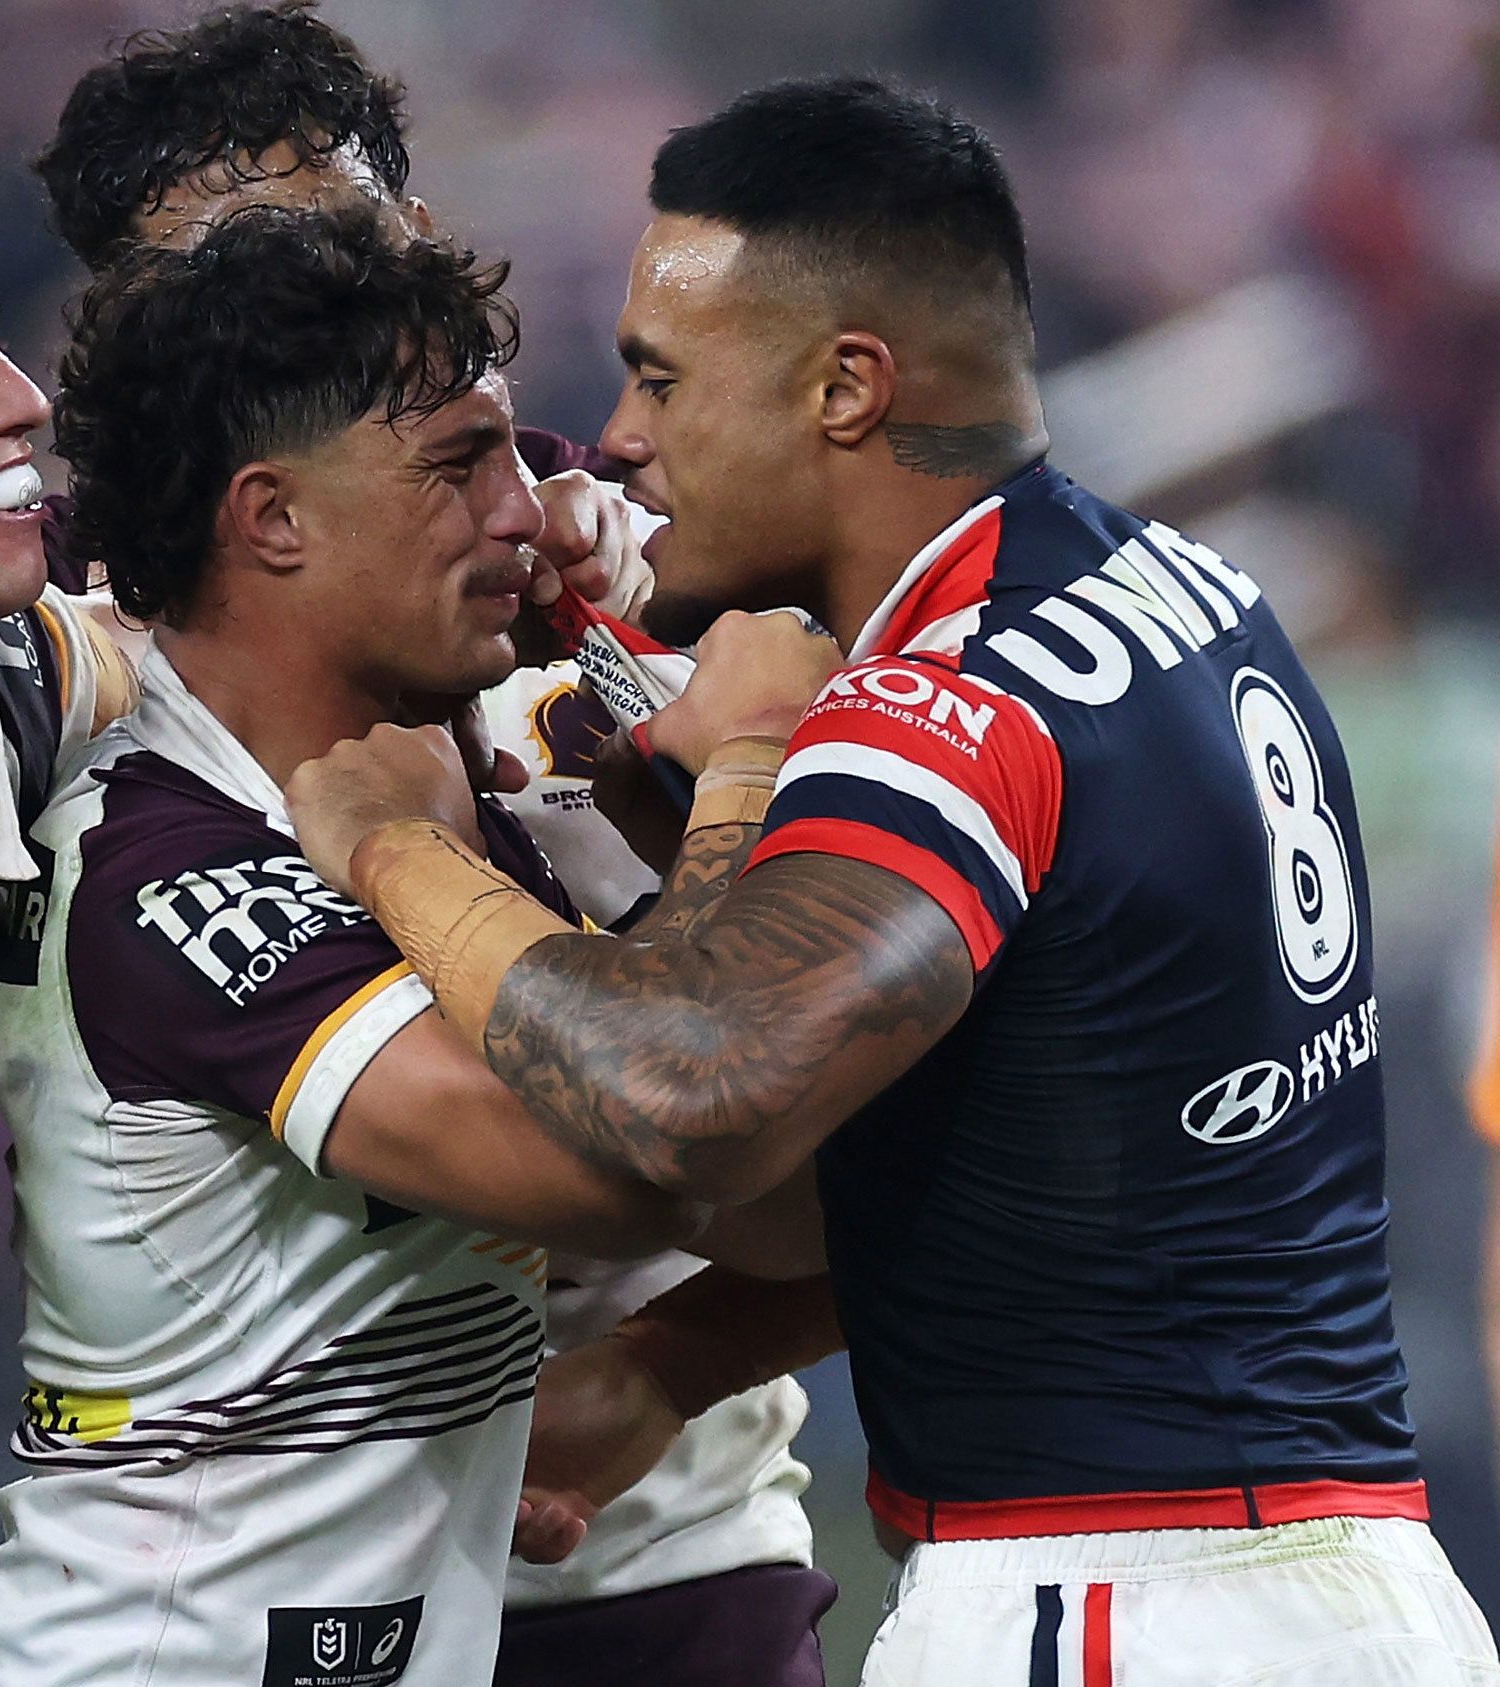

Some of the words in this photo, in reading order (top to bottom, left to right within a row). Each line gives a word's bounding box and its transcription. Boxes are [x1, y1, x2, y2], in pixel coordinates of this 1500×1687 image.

[871, 702, 979, 761] AUSTRALIA
[1230, 666, 1358, 1005] 8
[136, 856, 330, 947] firs
[224, 914, 328, 1007] HOME
